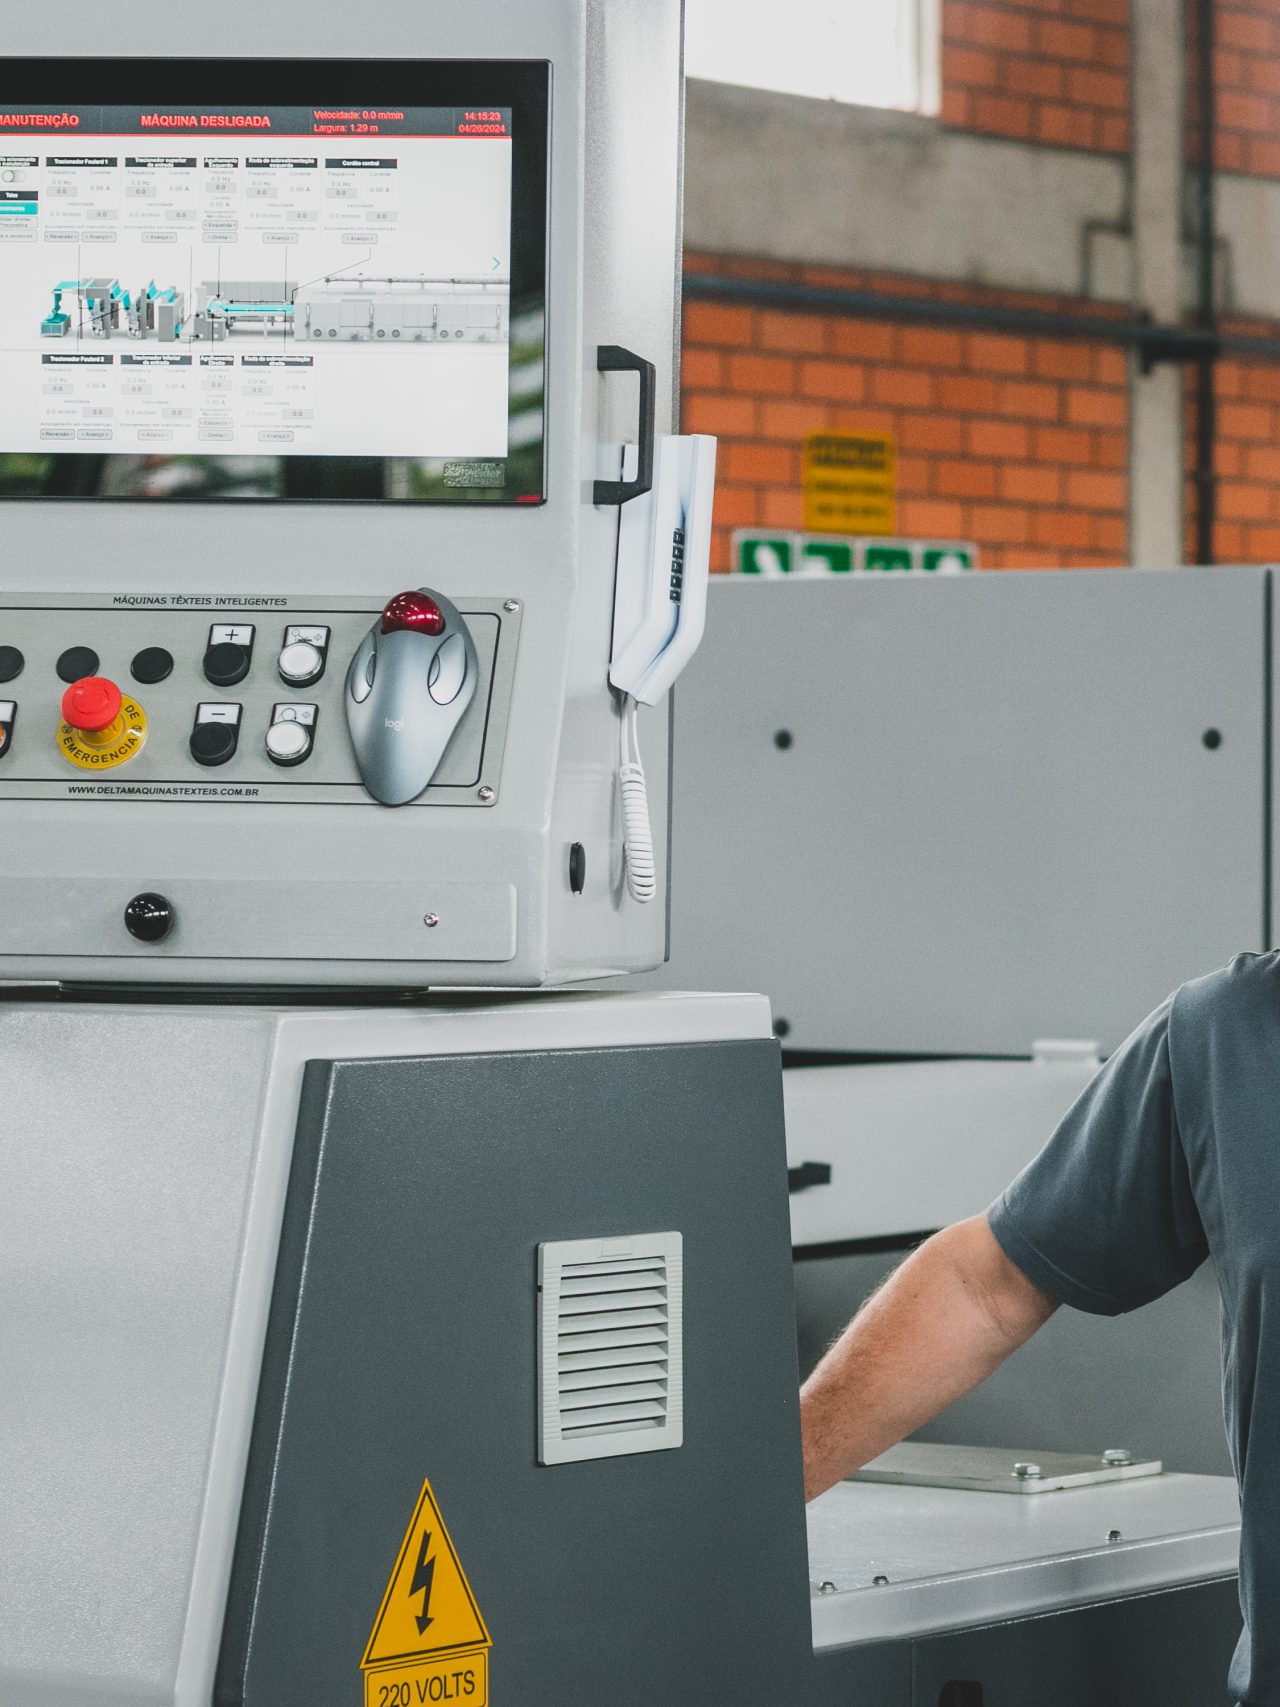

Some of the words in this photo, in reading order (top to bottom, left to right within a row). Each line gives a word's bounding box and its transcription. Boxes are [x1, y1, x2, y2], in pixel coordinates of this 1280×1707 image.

[140, 113, 198, 127] MÁQUINA
[201, 115, 271, 127] DESLIGADA
[313, 112, 360, 120] Velocidade:
[363, 112, 376, 120] 0.0
[378, 112, 404, 120] m/min
[313, 124, 349, 134] Largura:
[350, 124, 369, 133] 1.29
[113, 595, 167, 606] MÁQUINAS
[171, 595, 212, 606] TÊXTEIS
[215, 597, 288, 607] INTELIGENTES
[124, 704, 140, 720] DE
[63, 736, 138, 764] EMERGENCIA
[68, 786, 259, 797] WWW.DELTAMAQUINASTEXTEIS.COM.BR
[379, 1682, 411, 1707] 220
[416, 1670, 475, 1704] VOLTS
